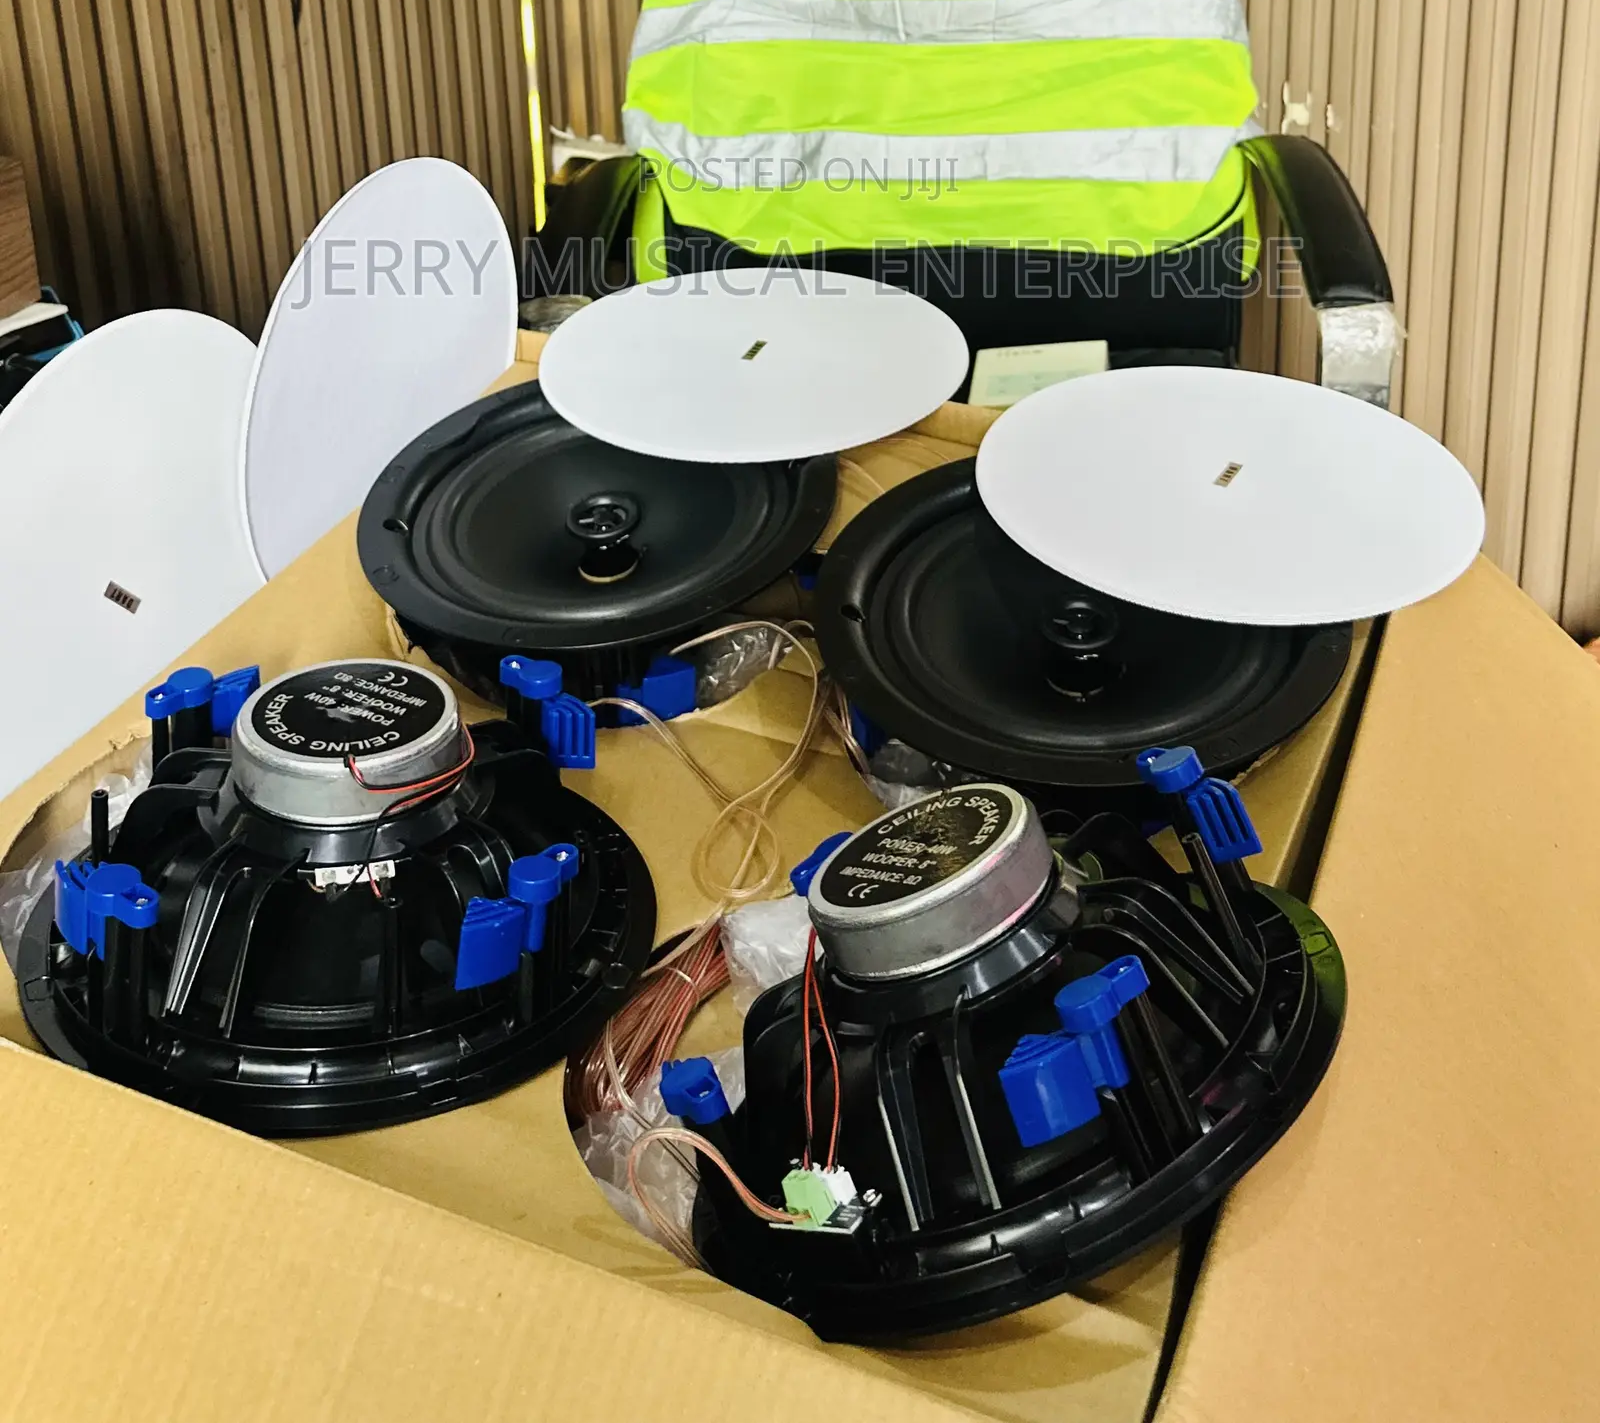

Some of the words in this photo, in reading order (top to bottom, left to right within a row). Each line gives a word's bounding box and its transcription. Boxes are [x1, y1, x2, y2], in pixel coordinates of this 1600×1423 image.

[304, 692, 337, 707] 40W
[343, 688, 407, 716] WOOFER:
[353, 678, 428, 707] IMPEDANCE:
[264, 693, 306, 746] SPEAKER
[337, 703, 395, 727] POWER:
[309, 730, 400, 752] CEILING
[877, 796, 963, 835] CEILING
[964, 796, 1000, 846] SPEAKER
